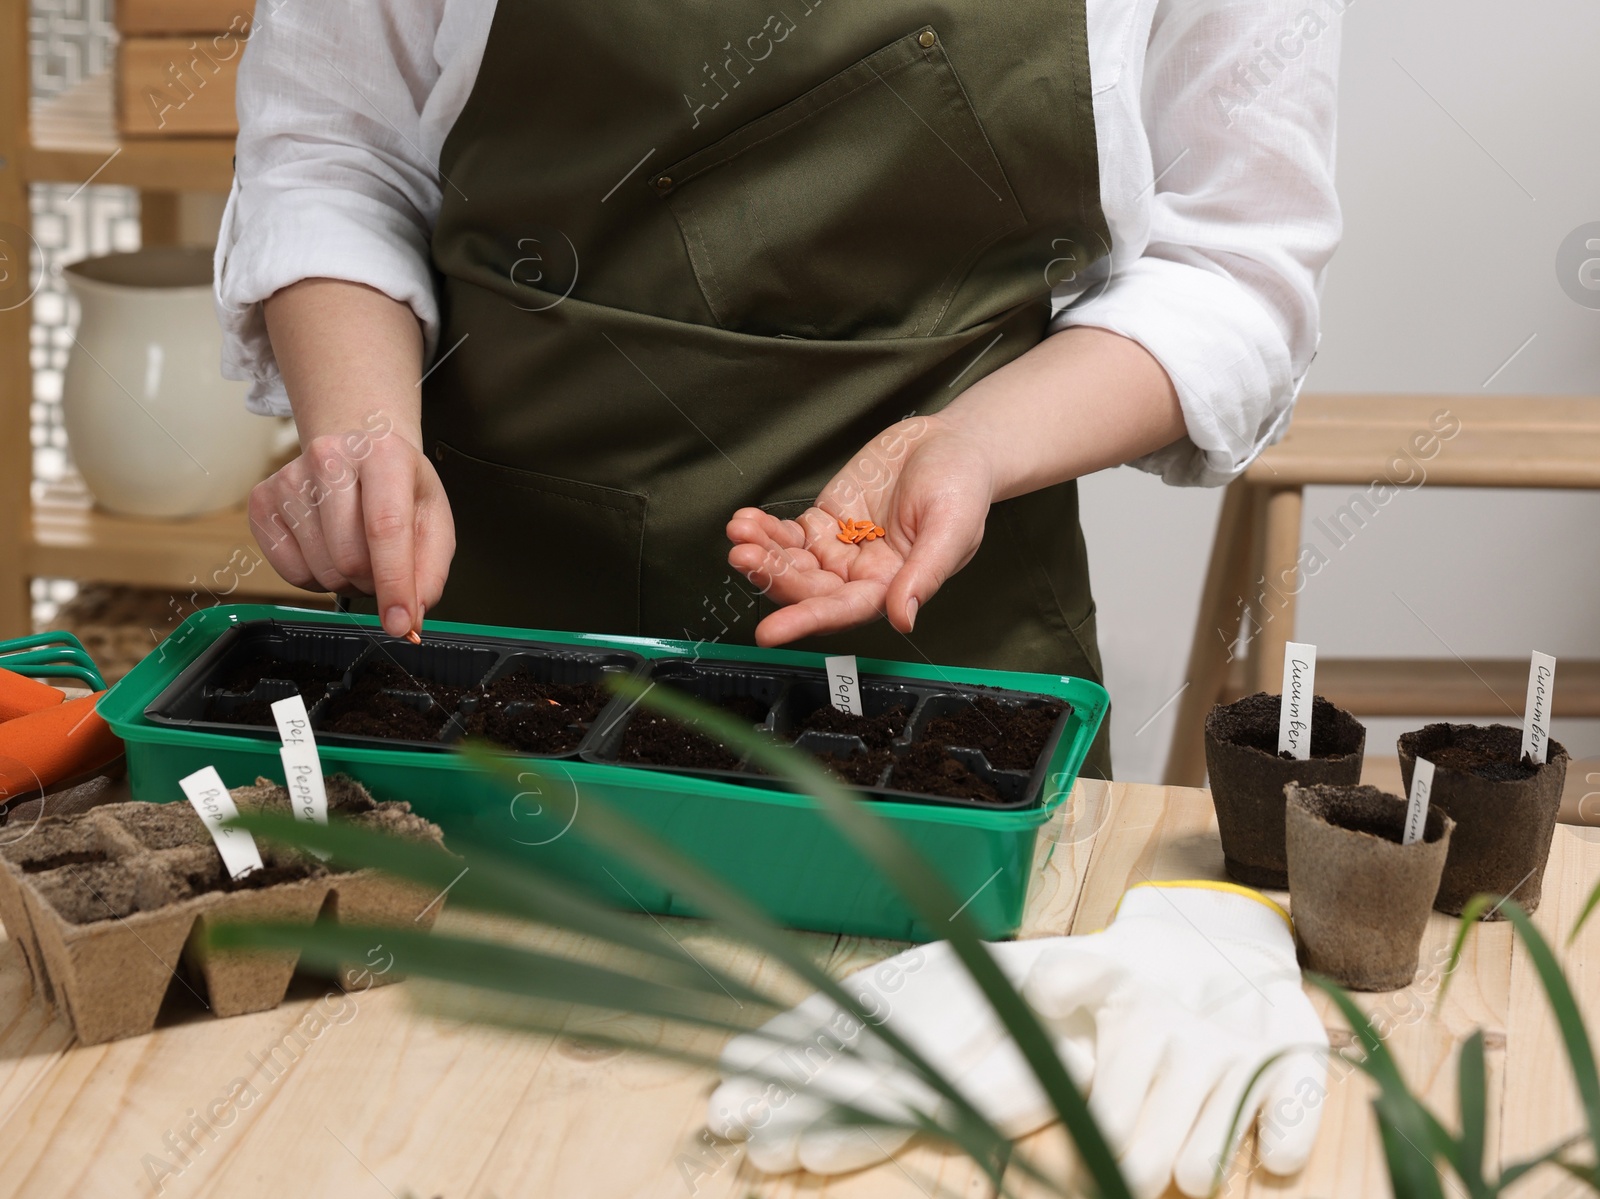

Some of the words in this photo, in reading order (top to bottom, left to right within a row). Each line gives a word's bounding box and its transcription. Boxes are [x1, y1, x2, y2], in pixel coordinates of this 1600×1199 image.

[1288, 659, 1308, 750] Cucumber
[1531, 665, 1551, 753] Cucumber
[198, 788, 234, 838] Peppr
